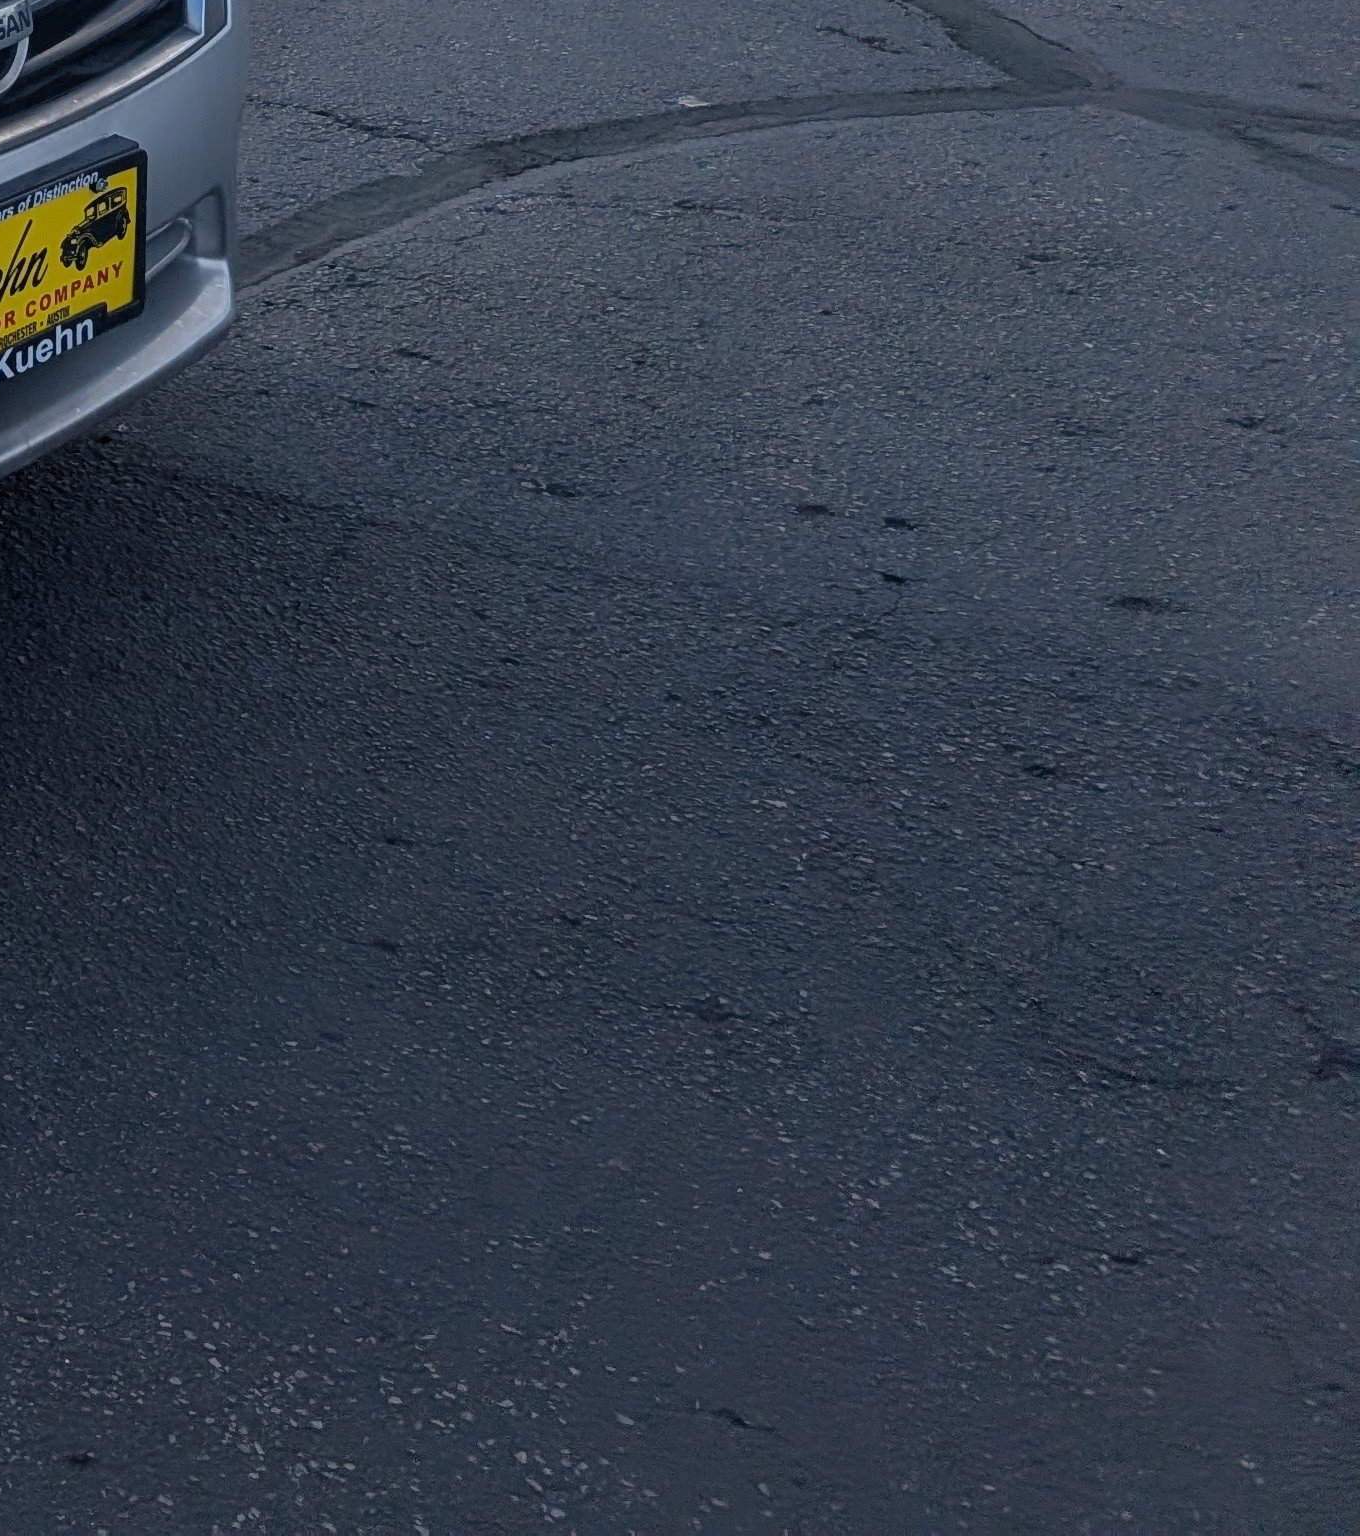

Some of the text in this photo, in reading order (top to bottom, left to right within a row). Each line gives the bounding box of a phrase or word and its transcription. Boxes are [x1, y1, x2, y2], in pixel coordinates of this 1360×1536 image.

[17, 194, 33, 215] of
[33, 170, 99, 206] Distinction
[25, 260, 125, 318] COMPANY
